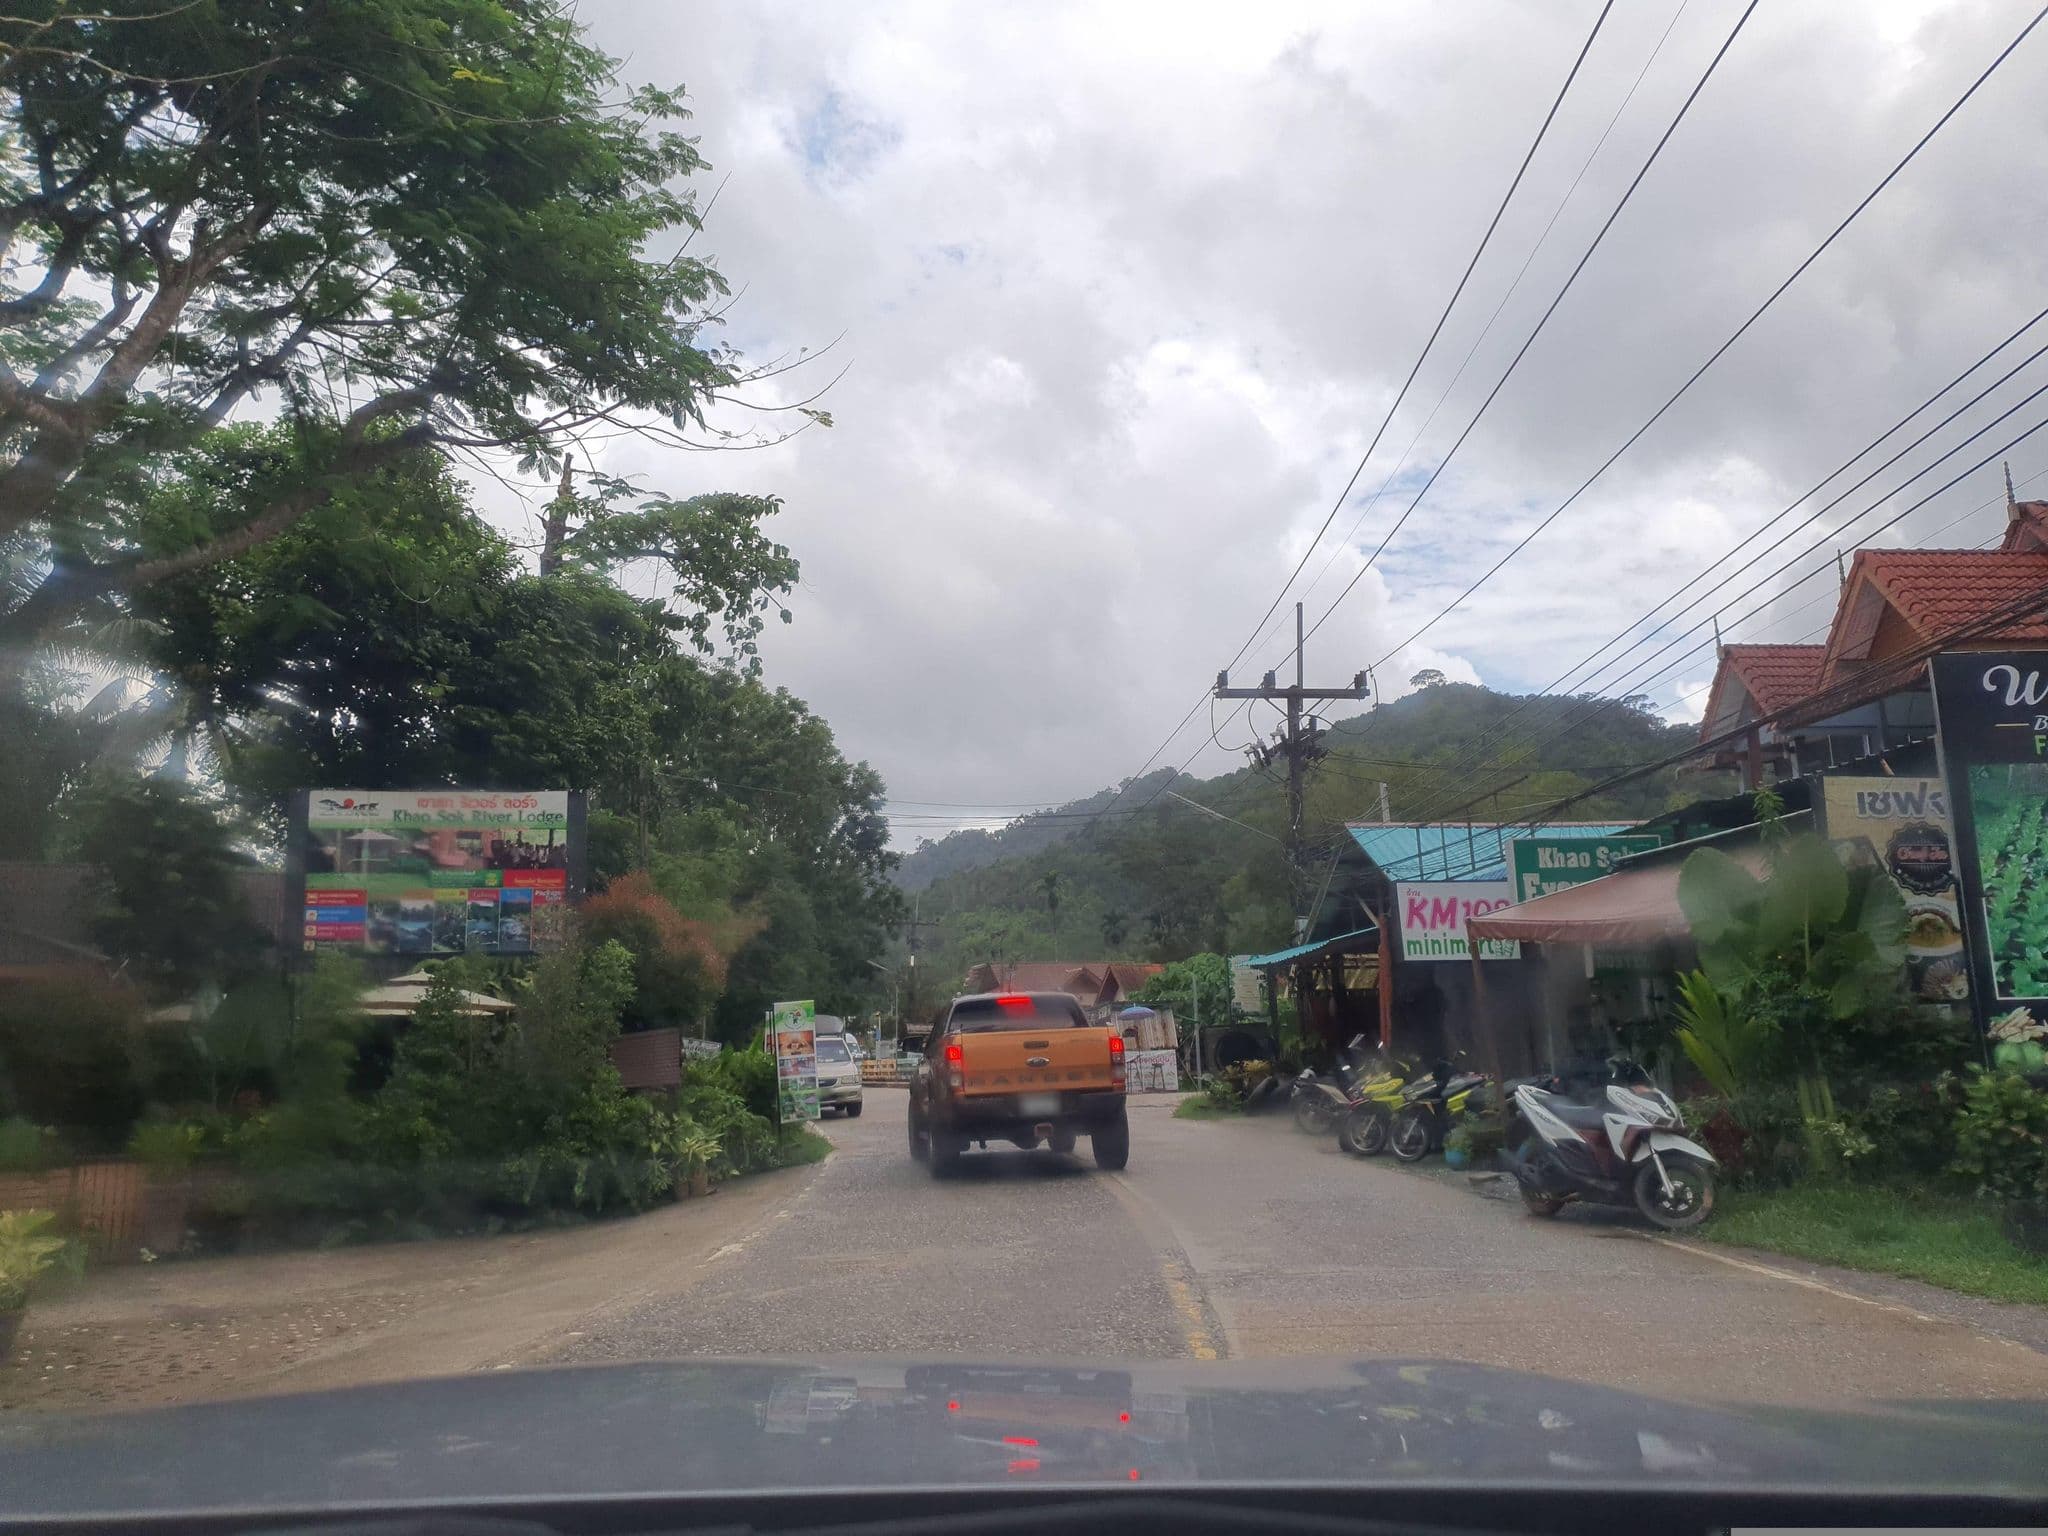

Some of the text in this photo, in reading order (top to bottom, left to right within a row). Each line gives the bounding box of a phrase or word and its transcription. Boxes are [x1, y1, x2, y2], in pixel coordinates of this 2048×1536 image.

[393, 810, 431, 823] Khao
[437, 810, 464, 823] Sok
[472, 810, 512, 823] River
[519, 810, 563, 826] Lodge
[1538, 848, 1591, 868] Khao
